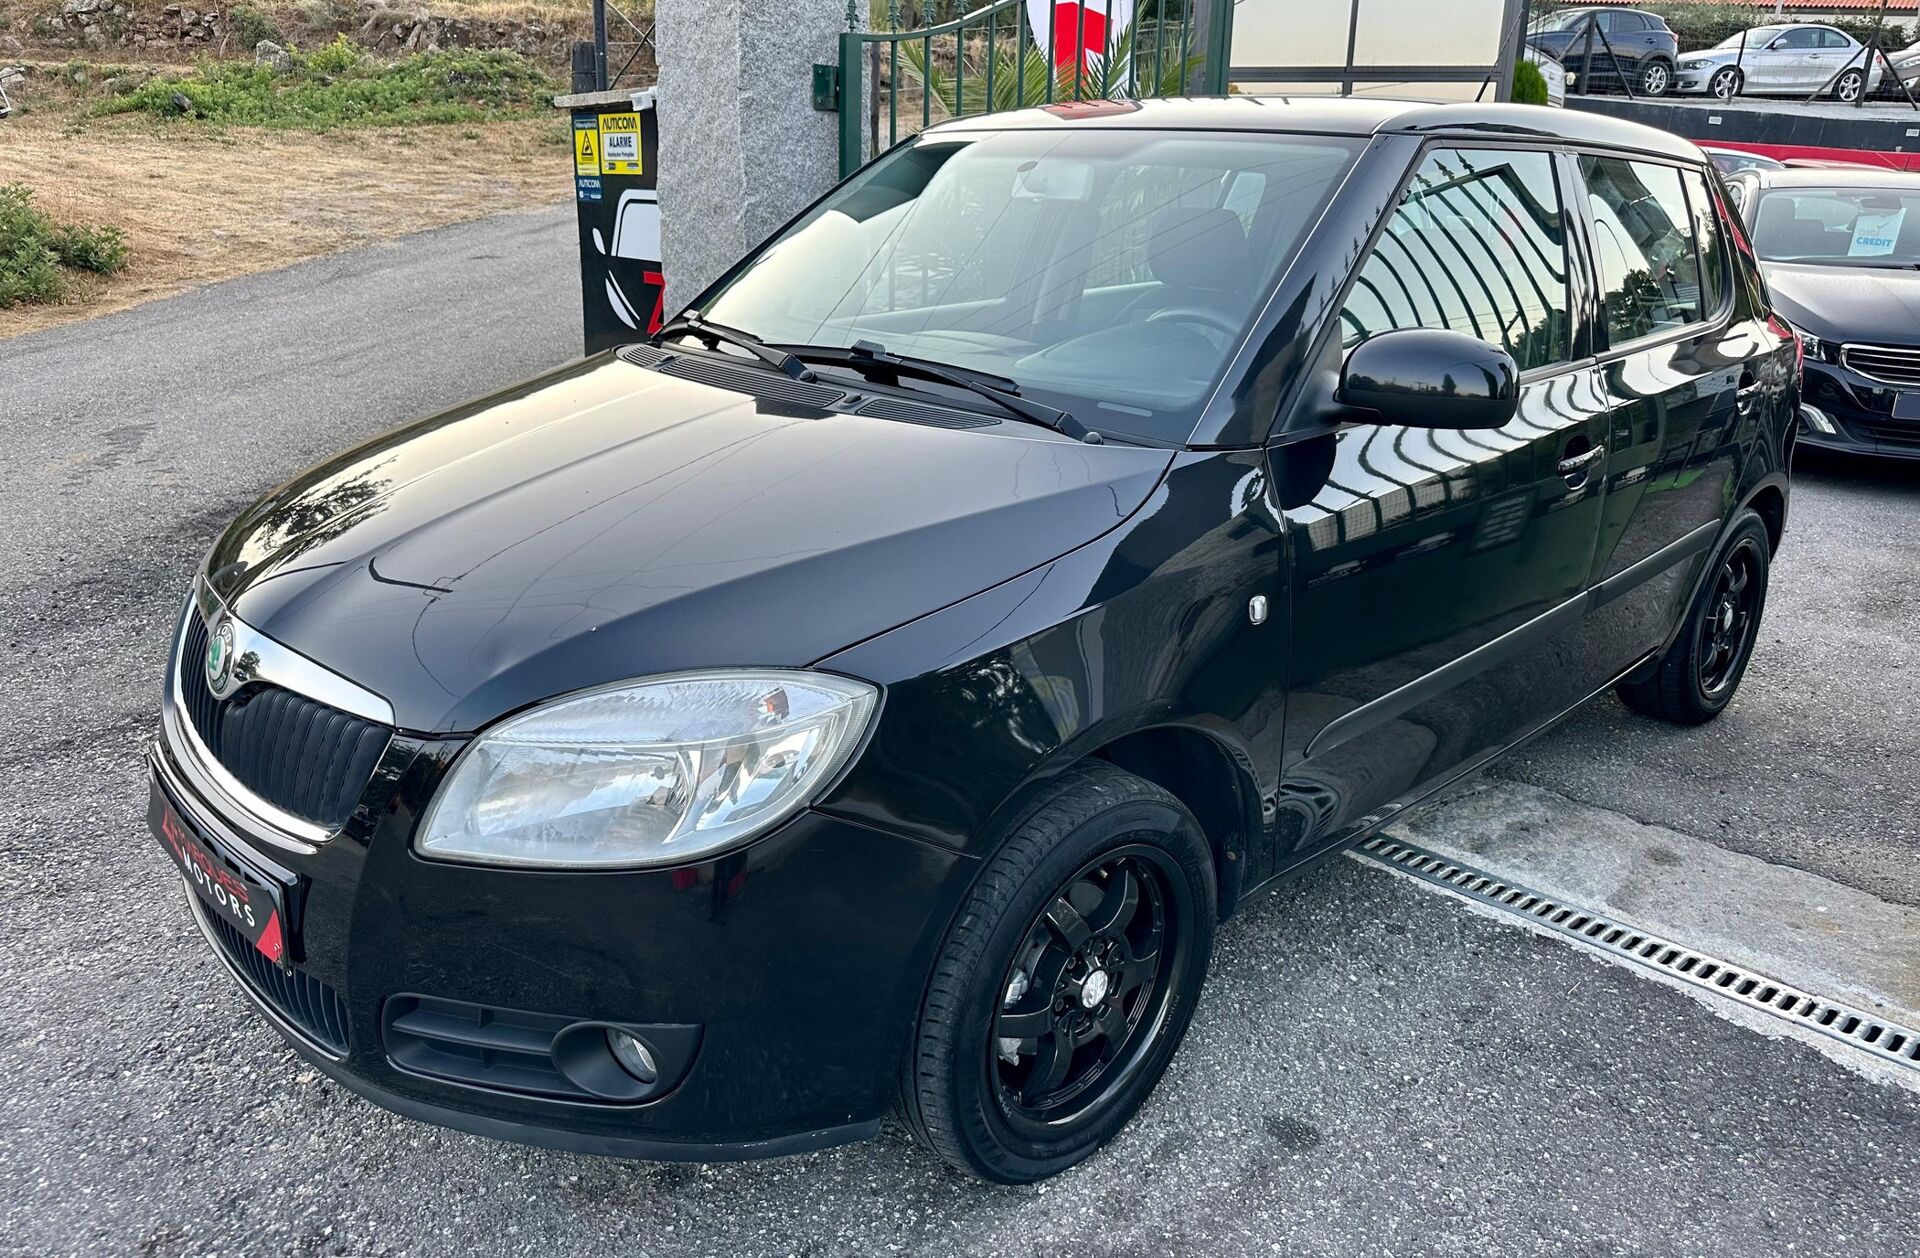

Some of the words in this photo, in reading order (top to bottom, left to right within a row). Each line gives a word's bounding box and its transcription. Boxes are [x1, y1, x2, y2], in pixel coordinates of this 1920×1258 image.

[609, 136, 632, 148] ALARME
[1856, 236, 1893, 247] CREDIT
[181, 845, 256, 928] MOTORS
